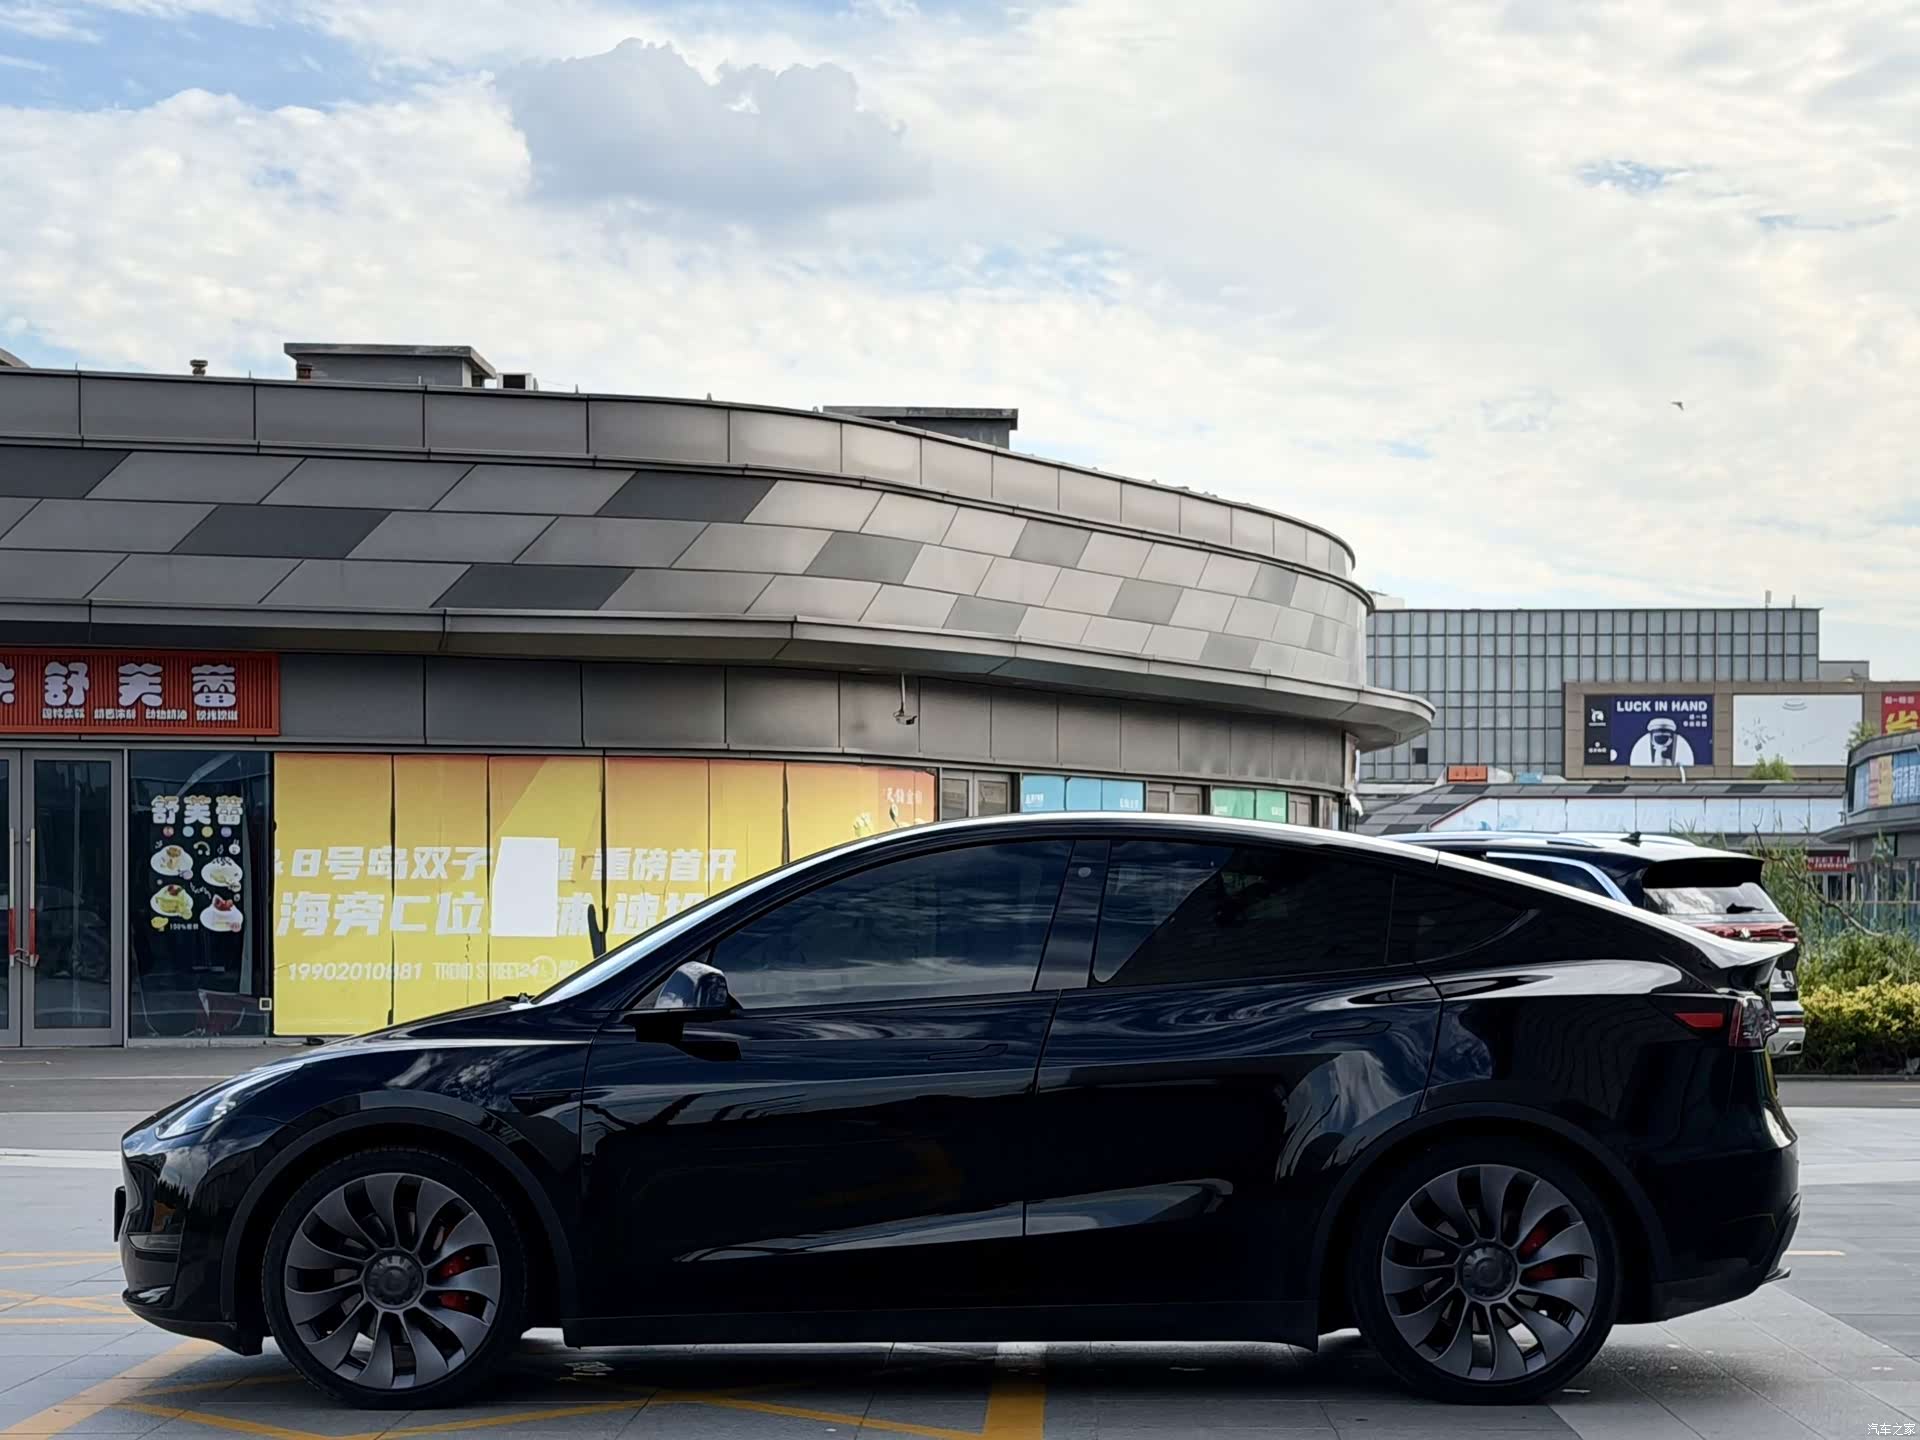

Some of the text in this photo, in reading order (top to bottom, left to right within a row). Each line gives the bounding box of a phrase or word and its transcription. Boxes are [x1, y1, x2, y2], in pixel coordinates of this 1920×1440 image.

[1616, 700, 1708, 712] LUCK IN HAND
[151, 794, 243, 825] 舒芙蕾
[591, 847, 737, 882] 重磅首开
